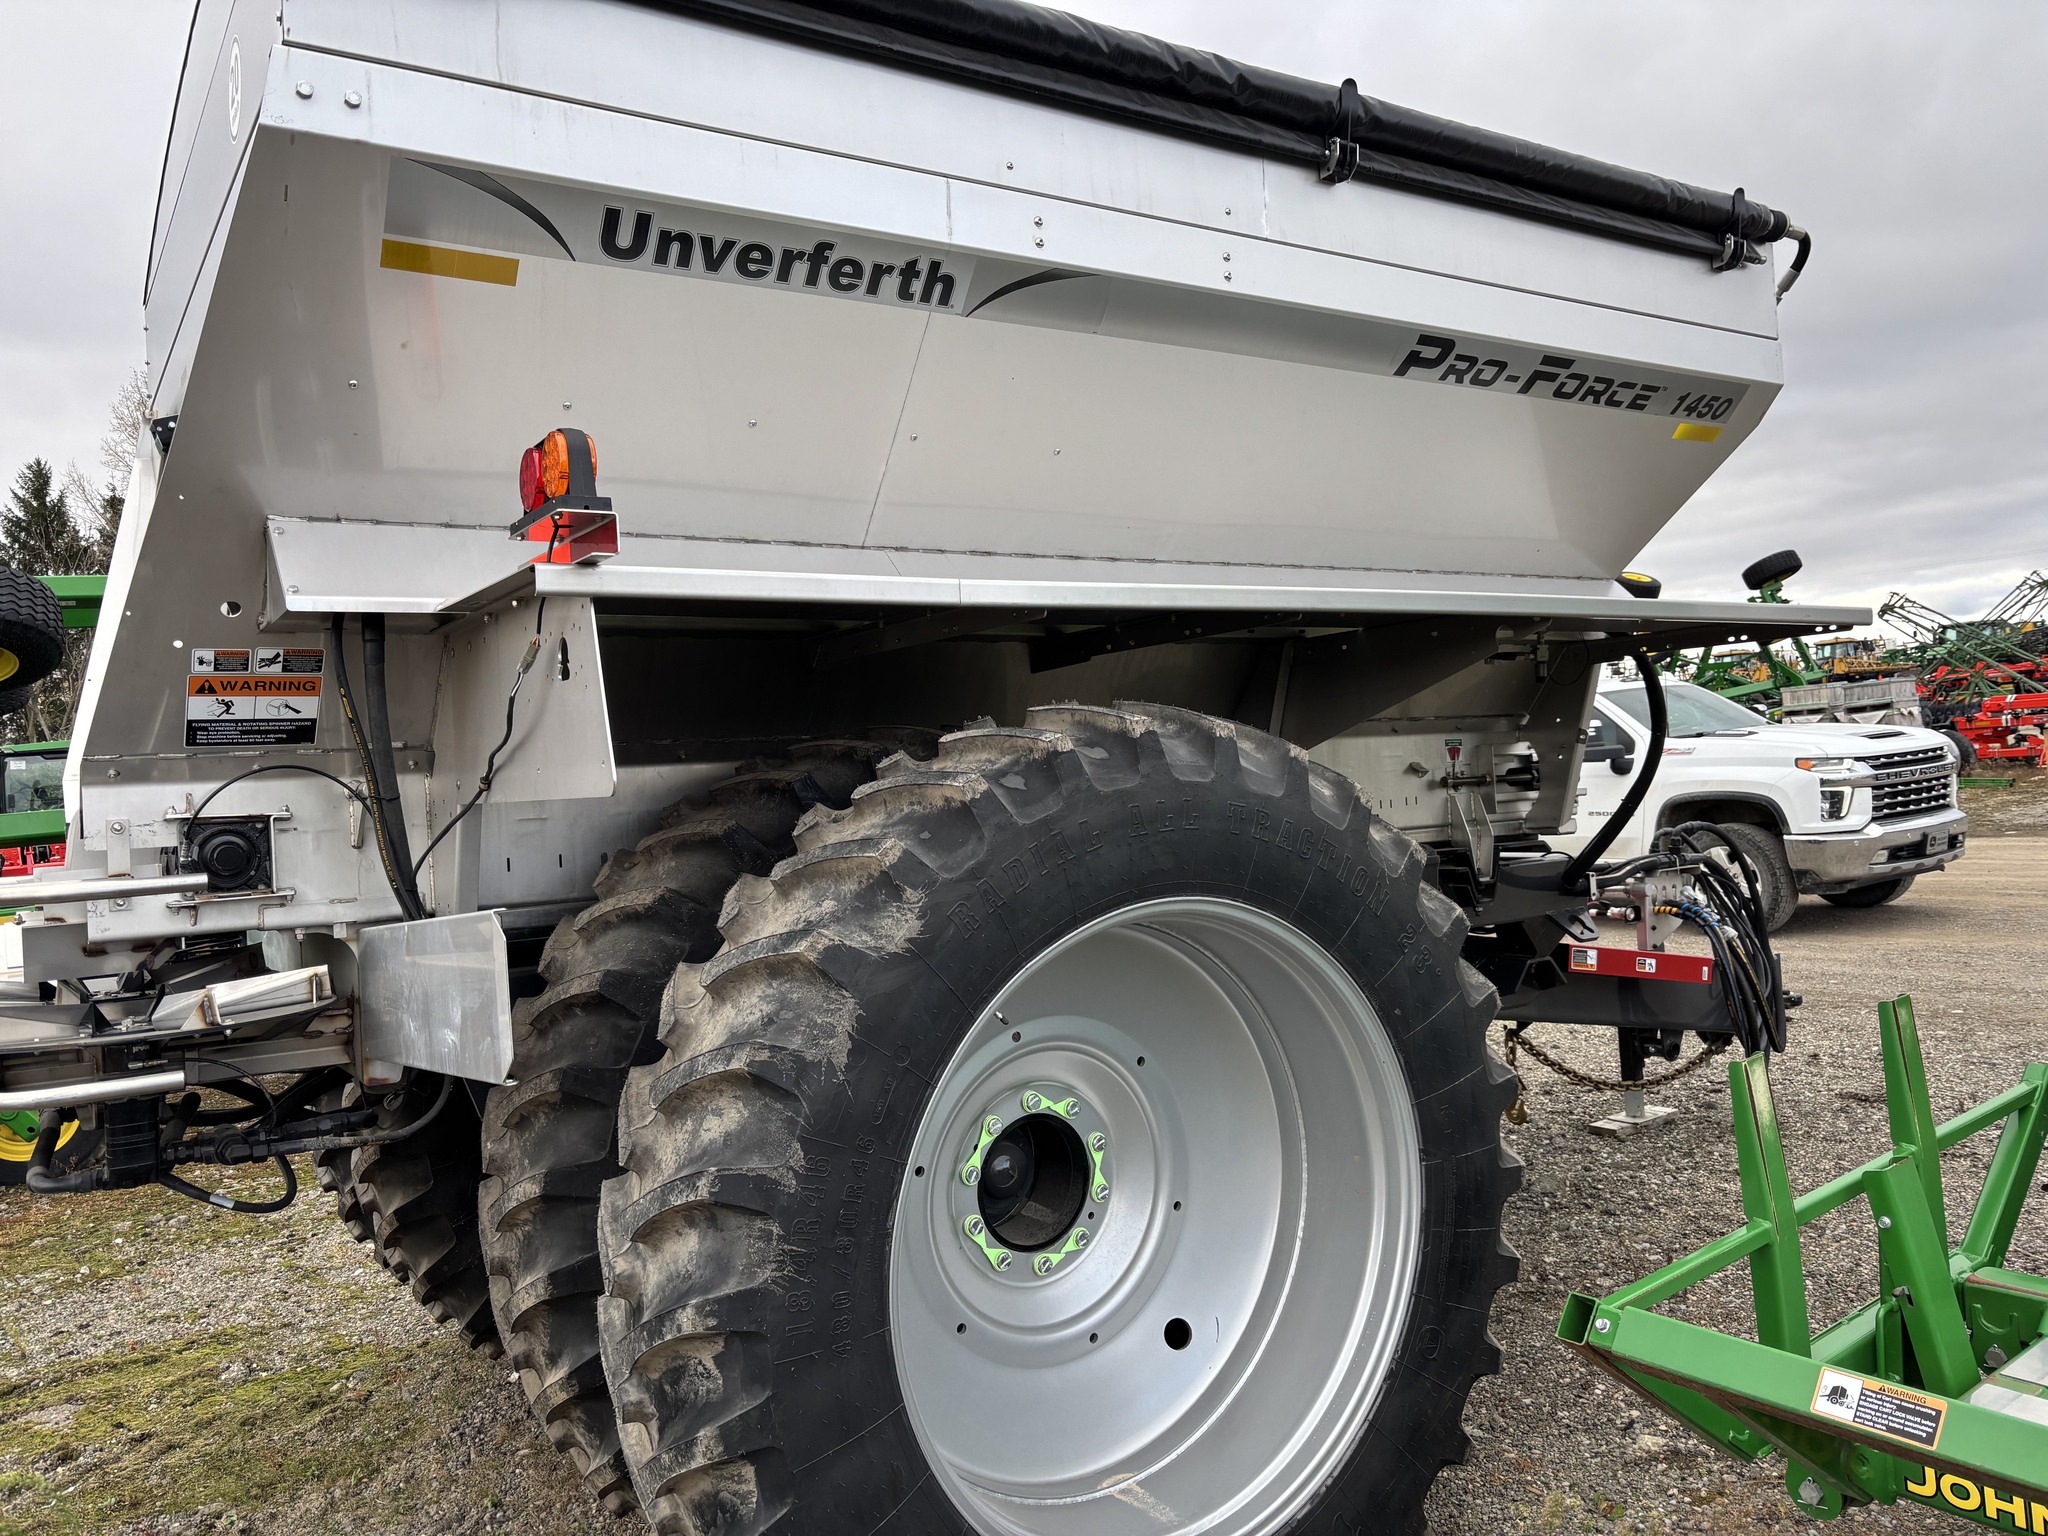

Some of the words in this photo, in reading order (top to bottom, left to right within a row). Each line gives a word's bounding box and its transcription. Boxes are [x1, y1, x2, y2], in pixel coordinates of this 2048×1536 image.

[599, 204, 955, 309] Unverferth
[1670, 391, 1734, 420] 1450
[220, 680, 316, 692] WARNING
[1876, 762, 1956, 782] CHEVROLET
[947, 818, 1103, 939] RADIAL
[1128, 797, 1199, 838] ALL
[1227, 800, 1392, 918] TRACTION
[1887, 1386, 1927, 1404] WARNING
[1856, 1412, 1872, 1420] STAND
[1872, 1416, 1888, 1424] CLEAR
[1859, 1401, 1879, 1410] ENGAGE
[1879, 1405, 1892, 1414] CART
[1892, 1410, 1905, 1418] LOCK
[1906, 1414, 1921, 1422] VALVE
